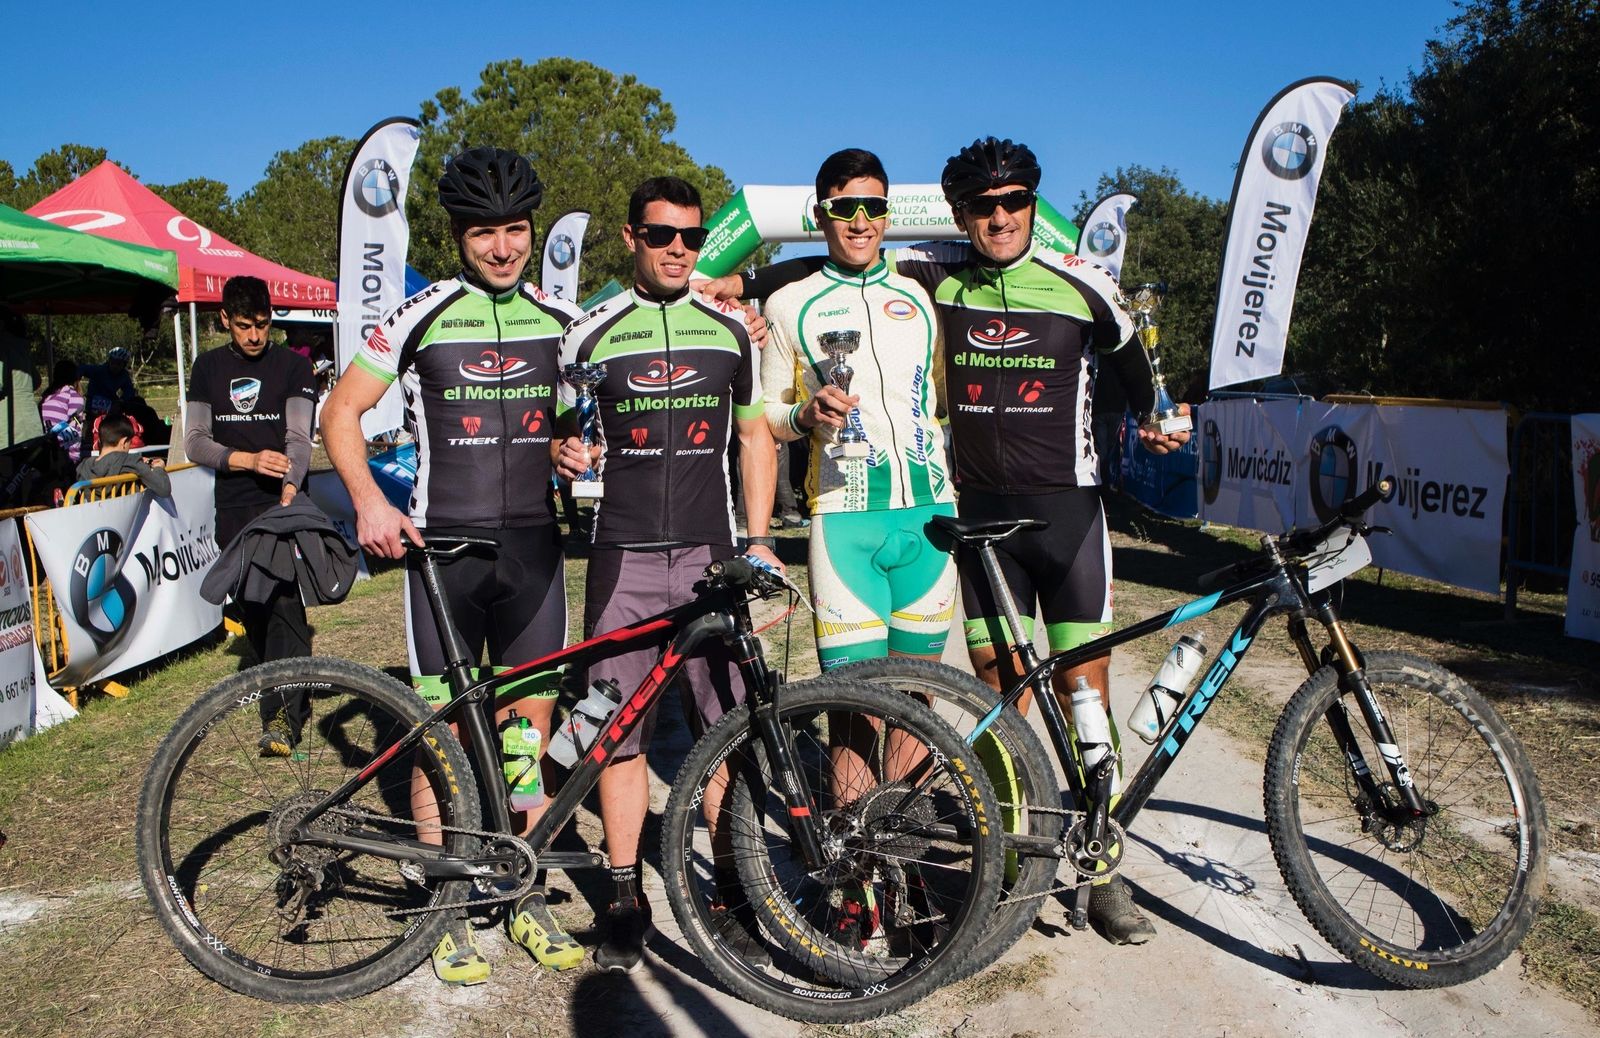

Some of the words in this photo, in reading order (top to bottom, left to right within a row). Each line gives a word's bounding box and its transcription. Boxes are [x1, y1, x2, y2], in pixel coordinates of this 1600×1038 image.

[1272, 122, 1316, 147] BMW
[358, 159, 397, 182] BMW
[902, 216, 955, 226] CICLISMO
[697, 228, 732, 262] NDALUZA
[708, 249, 721, 261] DE
[719, 219, 752, 252] CICLISMO
[1235, 201, 1292, 358] Movijerez
[384, 284, 442, 328] TREK
[504, 318, 541, 327] SHIMANO
[954, 352, 966, 366] el
[970, 352, 1056, 369] Motorista
[444, 388, 455, 401] el
[465, 383, 552, 401] Motorista
[911, 365, 923, 396] Lago
[616, 401, 631, 413] el
[634, 394, 721, 412] Motorista
[957, 403, 996, 414] TREK
[253, 413, 280, 421] TEAM
[447, 436, 500, 446] TREK
[511, 436, 550, 444] BONTRAGER
[620, 448, 664, 456] TREK
[675, 447, 715, 456] BONTRAGER
[1311, 428, 1357, 459] BMW
[237, 689, 263, 707] XXX
[584, 642, 683, 765] TREK
[1154, 626, 1253, 760] TREK
[415, 722, 459, 795] AXXIS
[707, 731, 748, 778] BONTRAGER
[928, 741, 948, 765] XXX
[690, 785, 705, 811] XXX
[952, 757, 989, 837] MAXXIS
[167, 875, 200, 928] BONTRAGER
[203, 933, 227, 955] XXX
[1359, 937, 1429, 971] MAXXIS
[257, 966, 272, 976] TLR
[792, 987, 852, 1000] BONTRAGER
[863, 982, 889, 997] XXX
